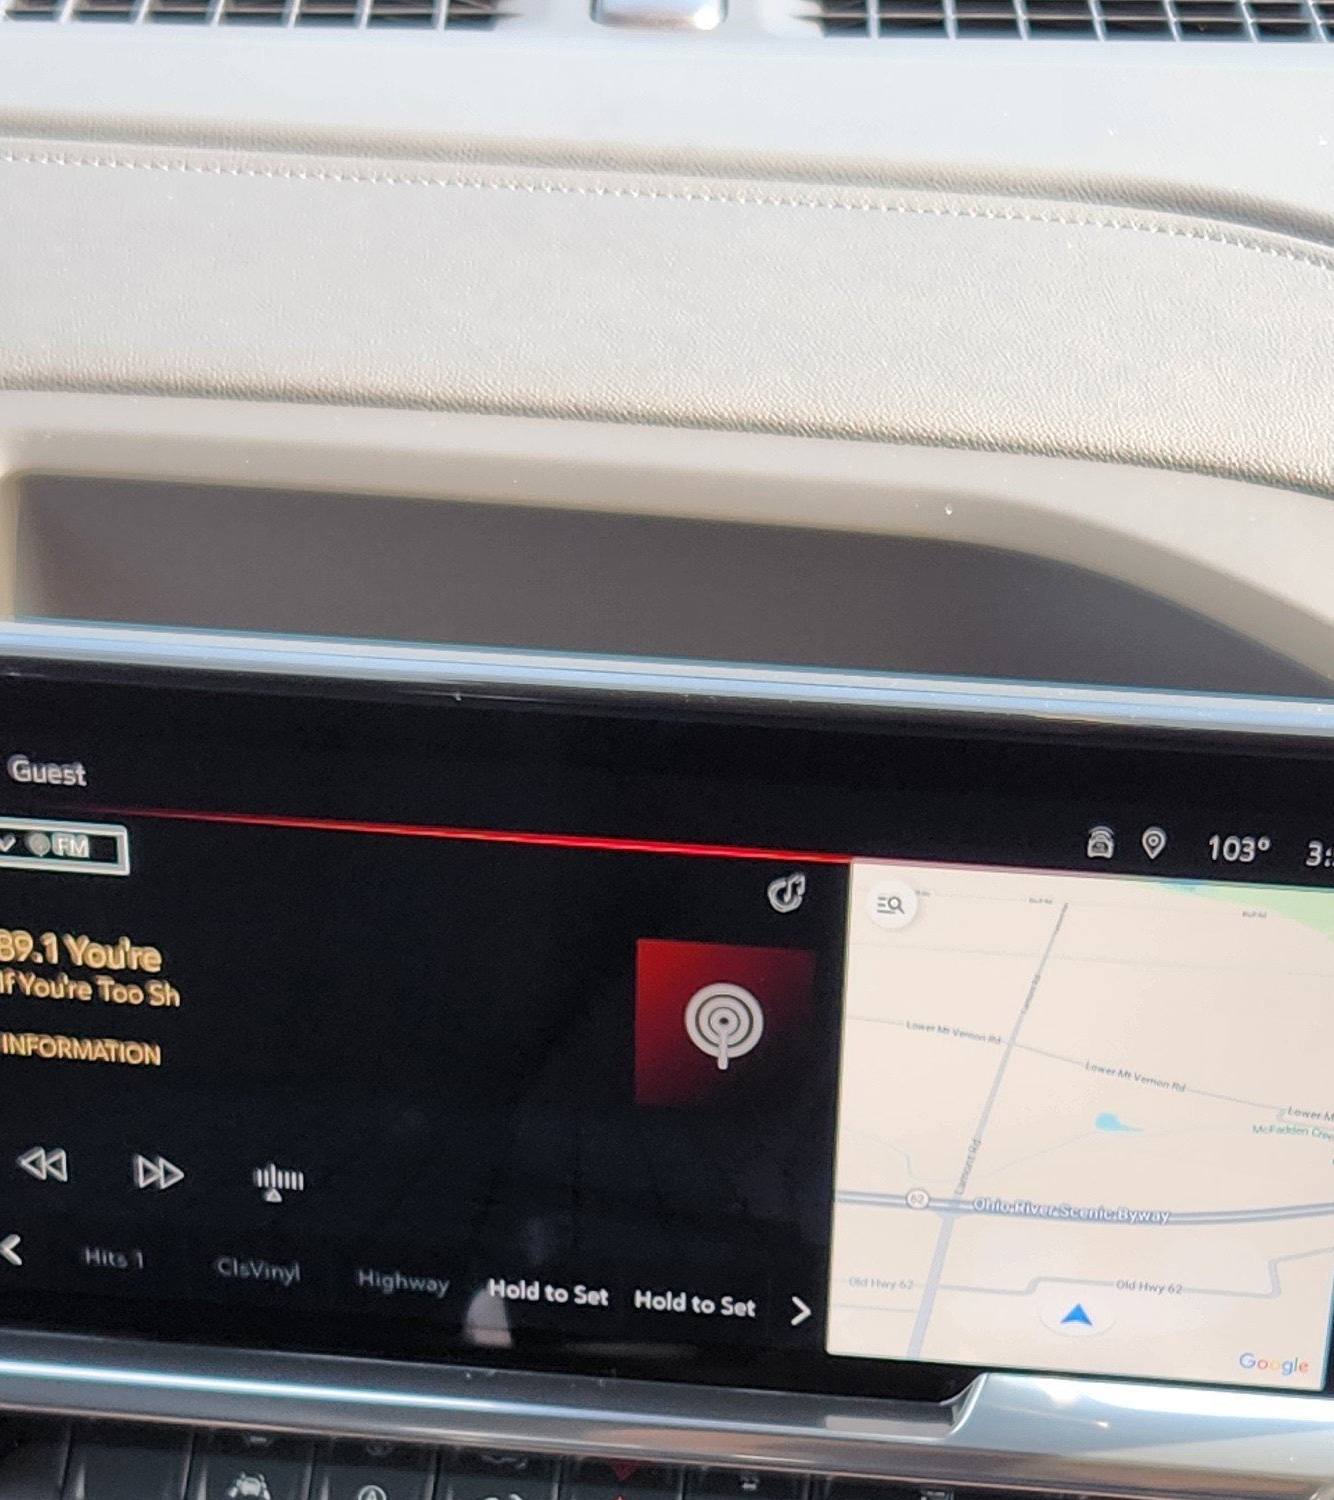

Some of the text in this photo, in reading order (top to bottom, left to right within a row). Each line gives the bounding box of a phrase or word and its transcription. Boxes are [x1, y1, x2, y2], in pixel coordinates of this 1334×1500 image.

[8, 753, 87, 787] Guest
[51, 832, 90, 858] FM
[63, 933, 162, 972] You're
[17, 971, 93, 1001] You're
[95, 974, 144, 1005] Too
[145, 979, 180, 1008] Sh
[1085, 1061, 1116, 1077] Lower
[1172, 1081, 1186, 1092] Rd
[1288, 1105, 1321, 1119] Lower
[1116, 1206, 1171, 1226] Byway
[85, 1247, 128, 1268] Hits
[358, 1269, 451, 1299] Highway
[487, 1278, 609, 1307] Hold to Set
[1168, 1284, 1183, 1295] 62
[634, 1289, 756, 1318] Hold to Set
[1238, 1352, 1310, 1376] Google
